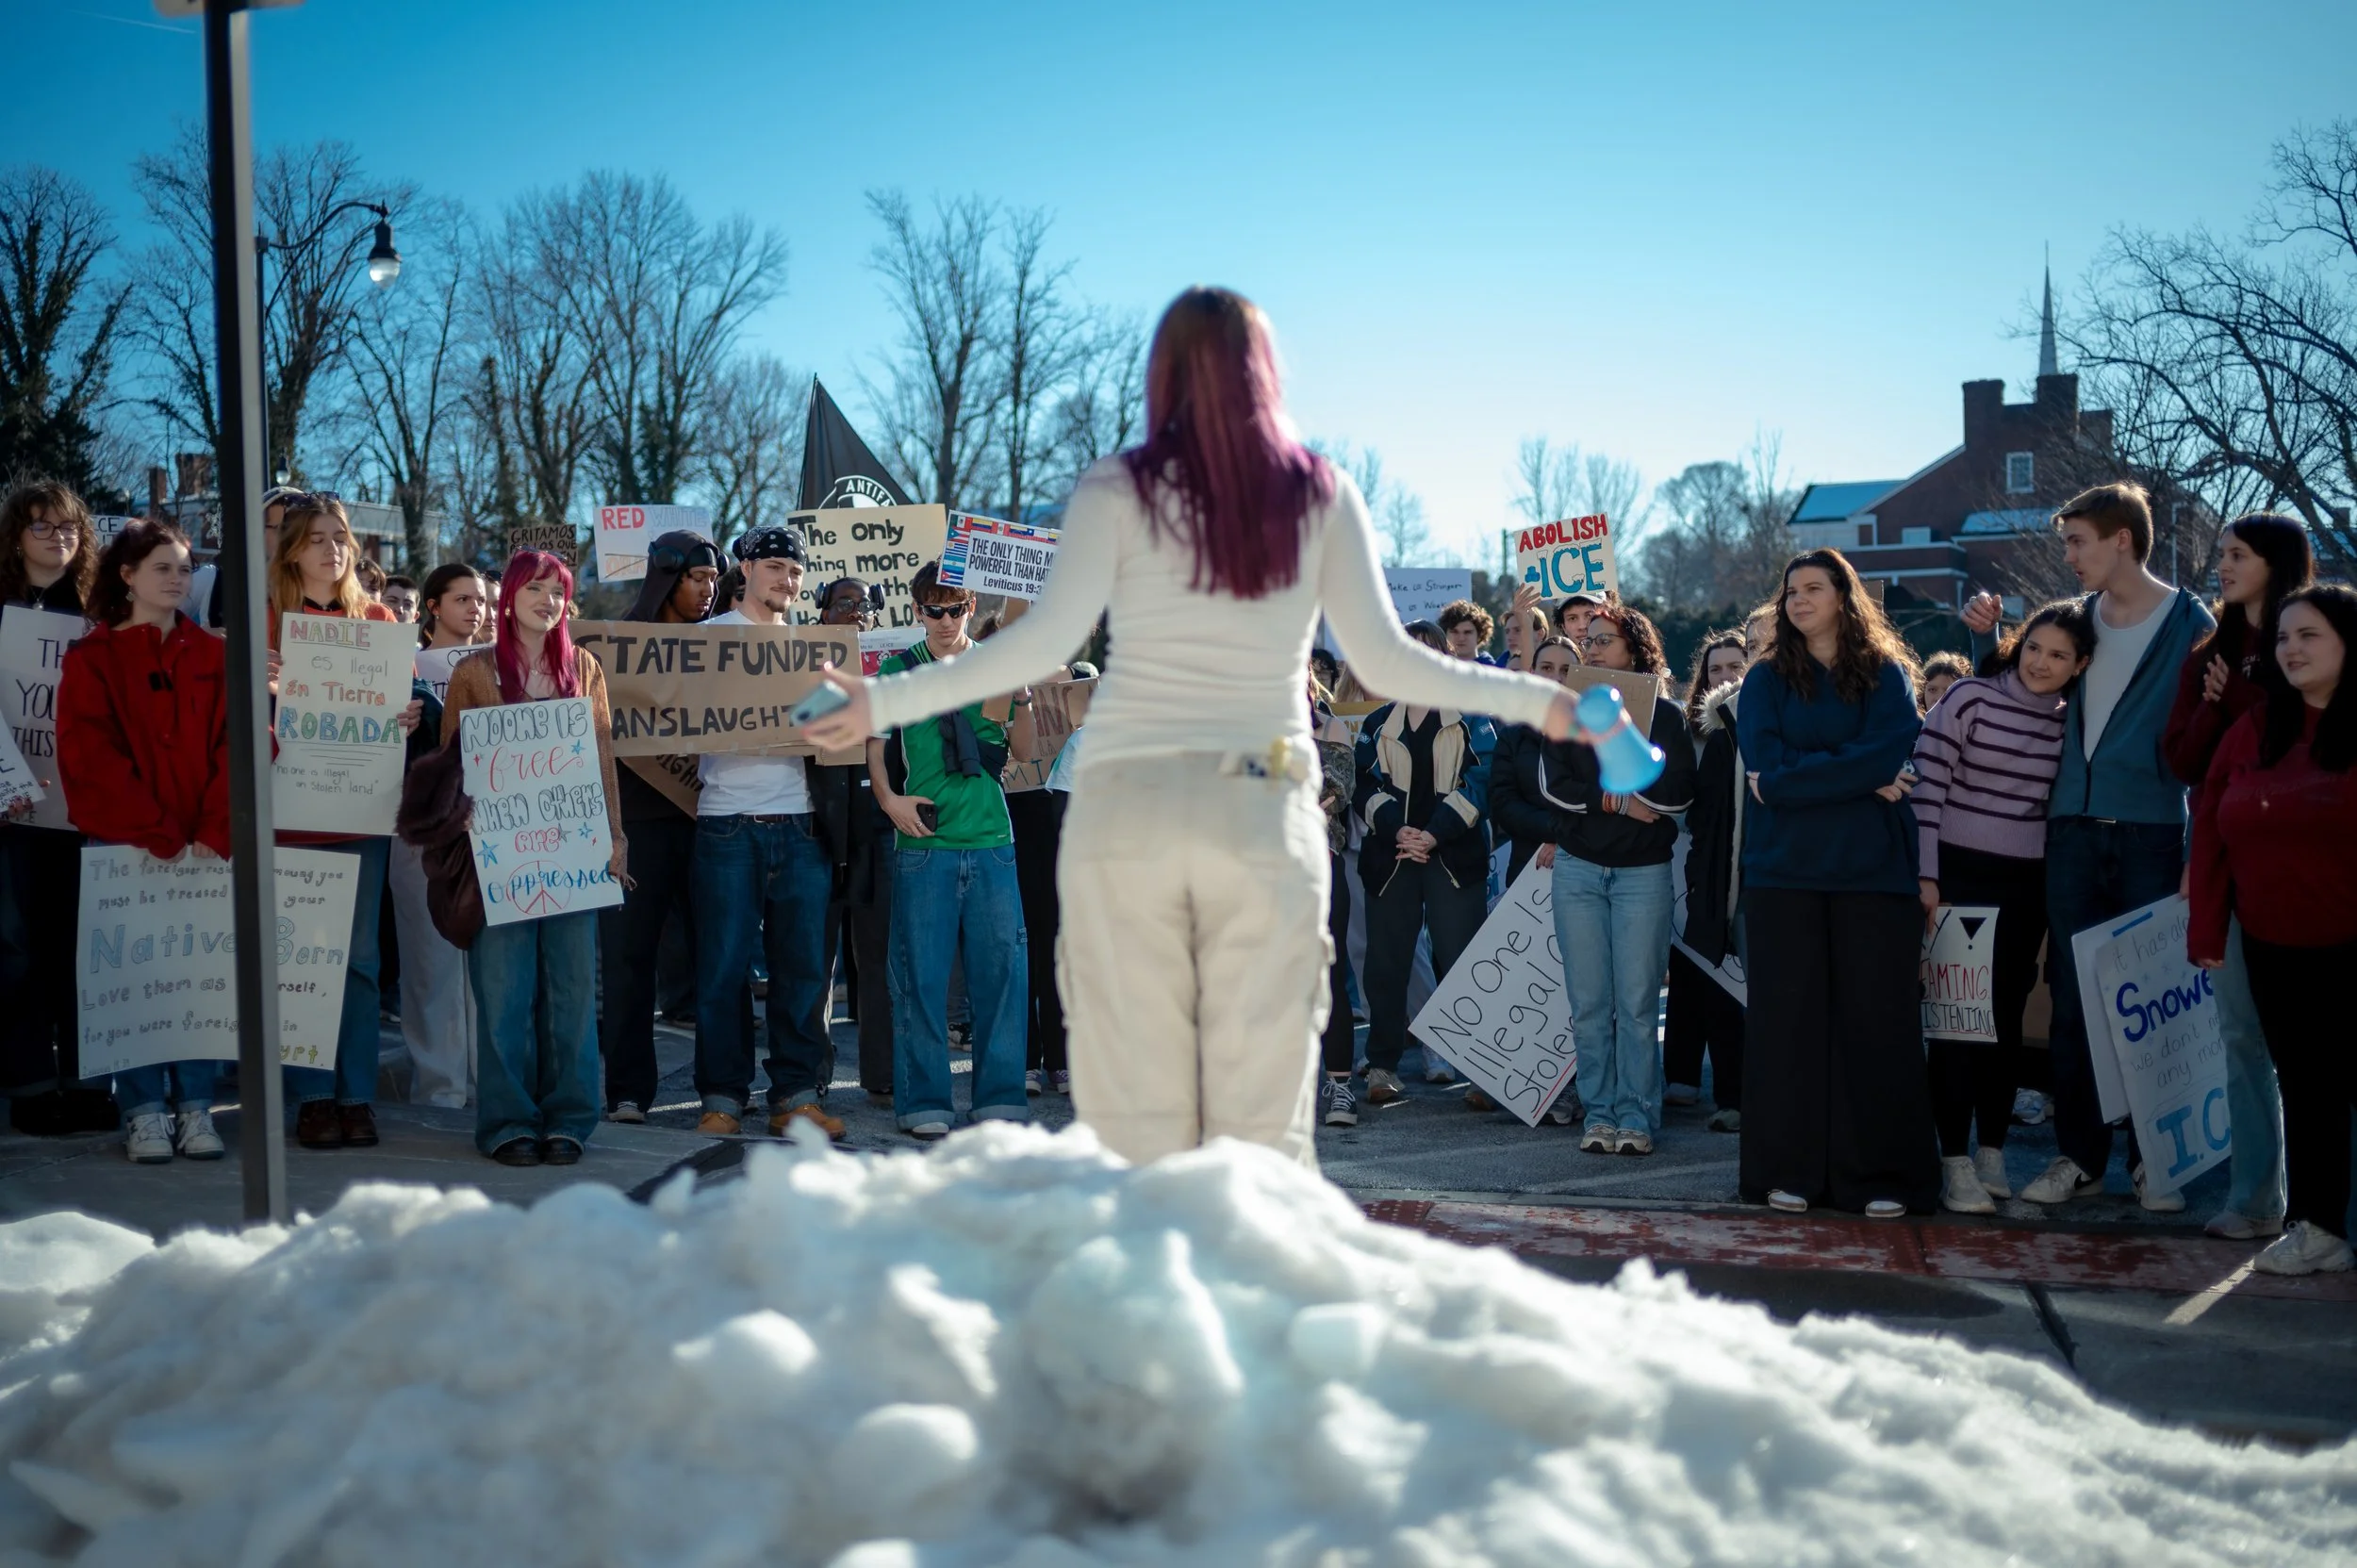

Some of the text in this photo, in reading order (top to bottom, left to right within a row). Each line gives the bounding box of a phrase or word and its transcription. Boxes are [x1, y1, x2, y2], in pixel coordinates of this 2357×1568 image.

[95, 518, 120, 533] CE
[511, 524, 576, 544] GRITAMOS
[601, 506, 646, 531] RED
[787, 515, 904, 546] The only
[1519, 514, 1607, 553] ABOLISH
[557, 539, 577, 553] QUE
[972, 537, 989, 555] THE
[990, 541, 1014, 559] ONLY
[1014, 545, 1043, 566] THING
[805, 552, 919, 578] hing more
[968, 553, 1051, 583] POWERFUL THAN HAT
[1537, 537, 1607, 598] ICE
[983, 576, 1023, 593] Leviticus
[290, 620, 371, 648] NADIE
[311, 655, 333, 671] es
[717, 640, 848, 676] FUNDED
[321, 681, 386, 706] Tierra
[278, 706, 402, 744] ROBADA
[555, 702, 588, 738] IS
[612, 703, 796, 741] ANSLAUGHT
[290, 767, 305, 776] one
[489, 746, 584, 793] free
[90, 859, 129, 881] The
[139, 890, 157, 905] be
[284, 896, 326, 908] your
[90, 916, 344, 974] Native Born
[2132, 932, 2167, 963] has
[82, 986, 130, 1011] Love
[143, 978, 191, 999] them
[200, 977, 226, 992] as
[1428, 997, 1482, 1055] No
[1471, 931, 1531, 993] One
[2116, 968, 2213, 1043] Snowe
[84, 1026, 104, 1045] for
[106, 1027, 130, 1047] you
[139, 1019, 173, 1033] were
[182, 1010, 239, 1033] foreig
[1464, 961, 1561, 1080] Illegal
[2131, 1051, 2154, 1073] we
[2161, 1023, 2200, 1059] don't
[2156, 1060, 2192, 1089] any
